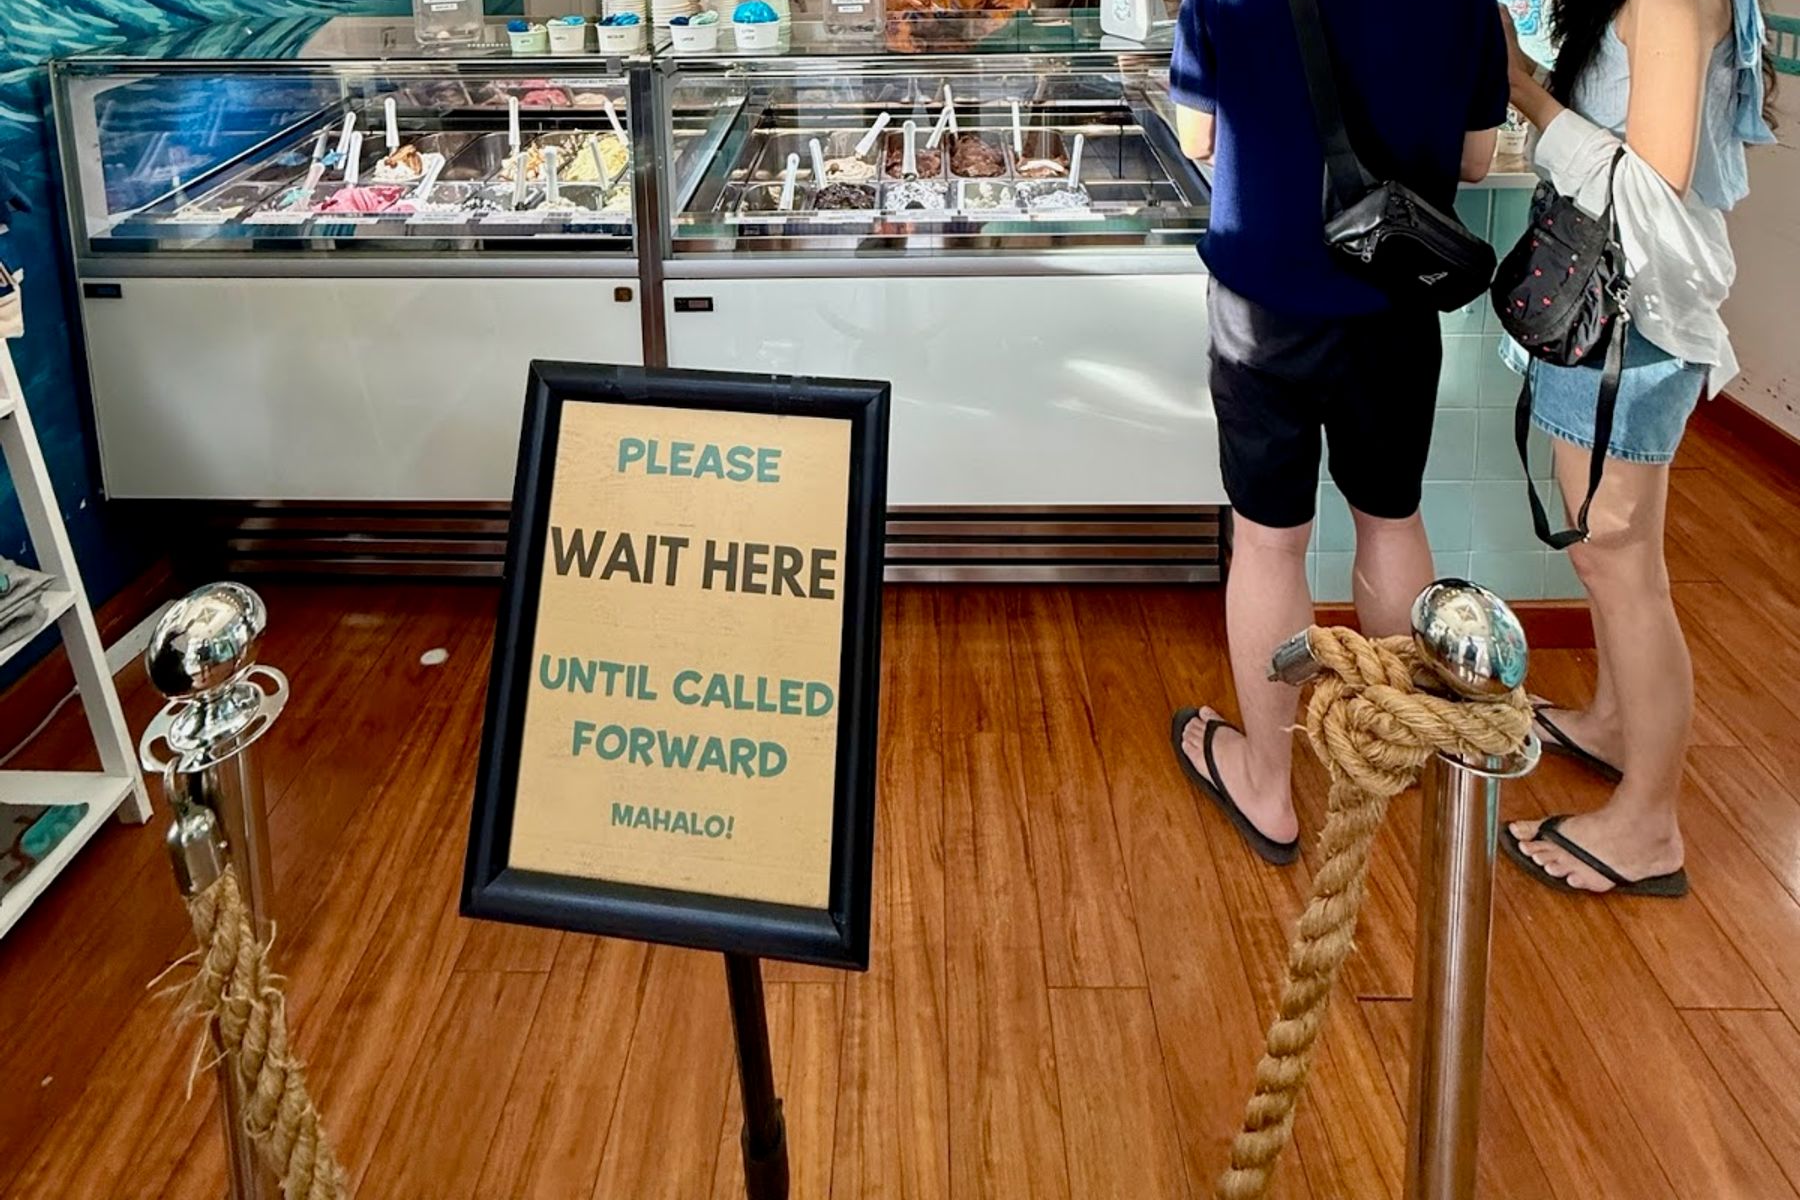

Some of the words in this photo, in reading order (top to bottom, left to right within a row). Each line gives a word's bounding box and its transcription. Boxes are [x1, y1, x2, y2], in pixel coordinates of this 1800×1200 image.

[617, 436, 782, 484] PLEASE
[551, 527, 689, 586] WAIT
[702, 539, 838, 600] HERE
[539, 655, 657, 700] UNTIL
[672, 669, 834, 717] CALLED
[572, 720, 788, 778] FORWARD
[611, 802, 735, 840] MAHALO!
